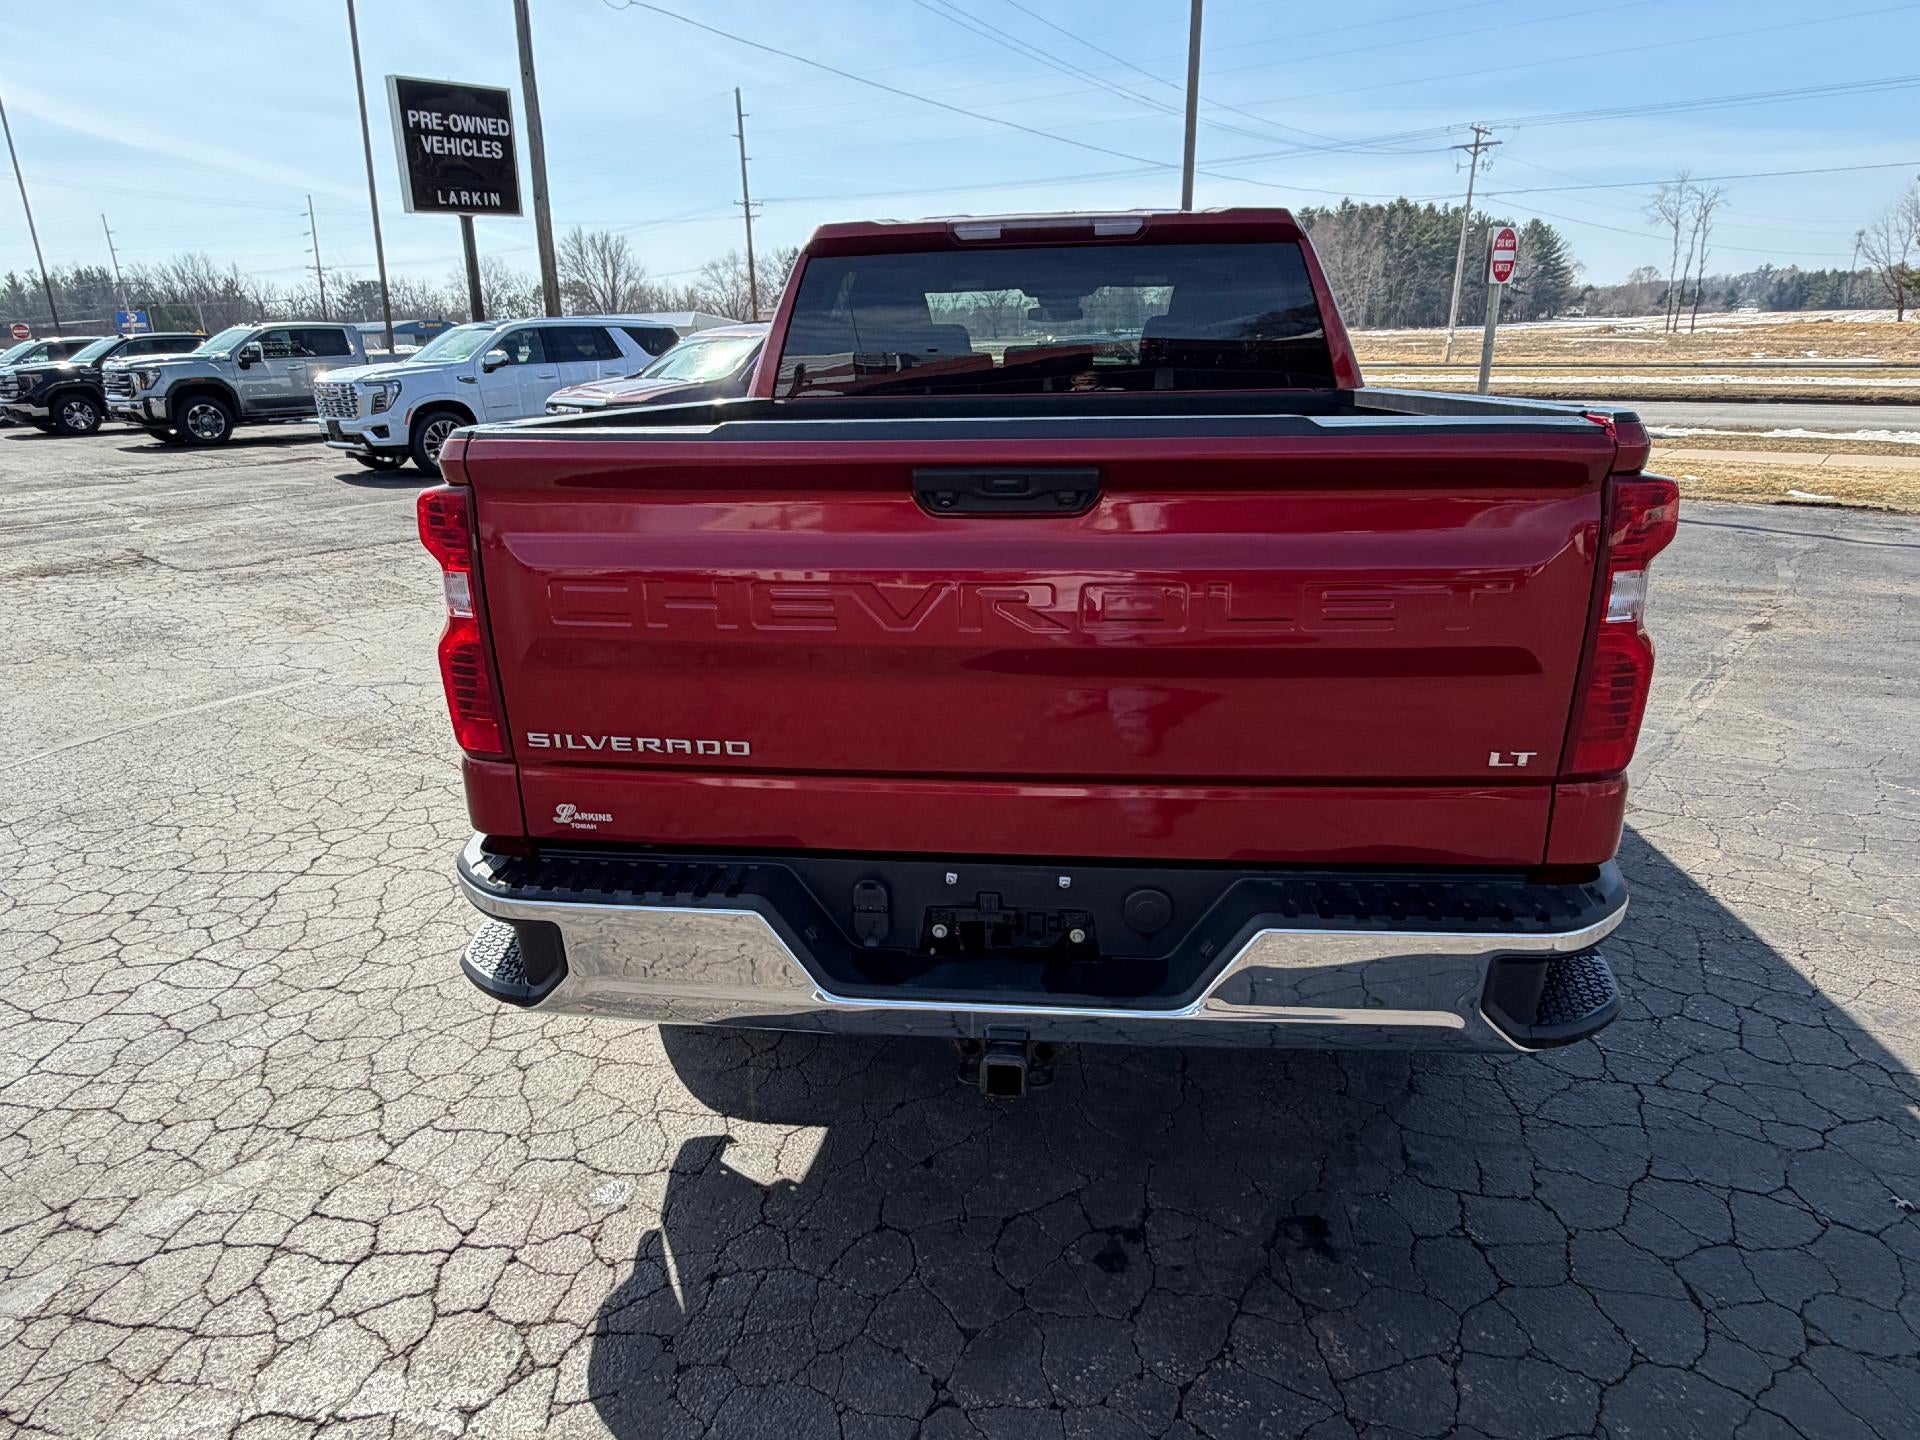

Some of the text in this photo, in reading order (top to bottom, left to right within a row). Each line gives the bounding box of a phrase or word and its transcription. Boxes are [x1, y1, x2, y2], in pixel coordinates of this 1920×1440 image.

[407, 109, 510, 137] PRE-OWNED
[420, 134, 503, 159] VEHICLES
[437, 190, 501, 206] LARKIN
[547, 577, 1514, 633] CHEVROLET
[526, 731, 751, 756] SILVERADO
[1488, 751, 1538, 767] LT
[552, 803, 613, 824] LARKINS
